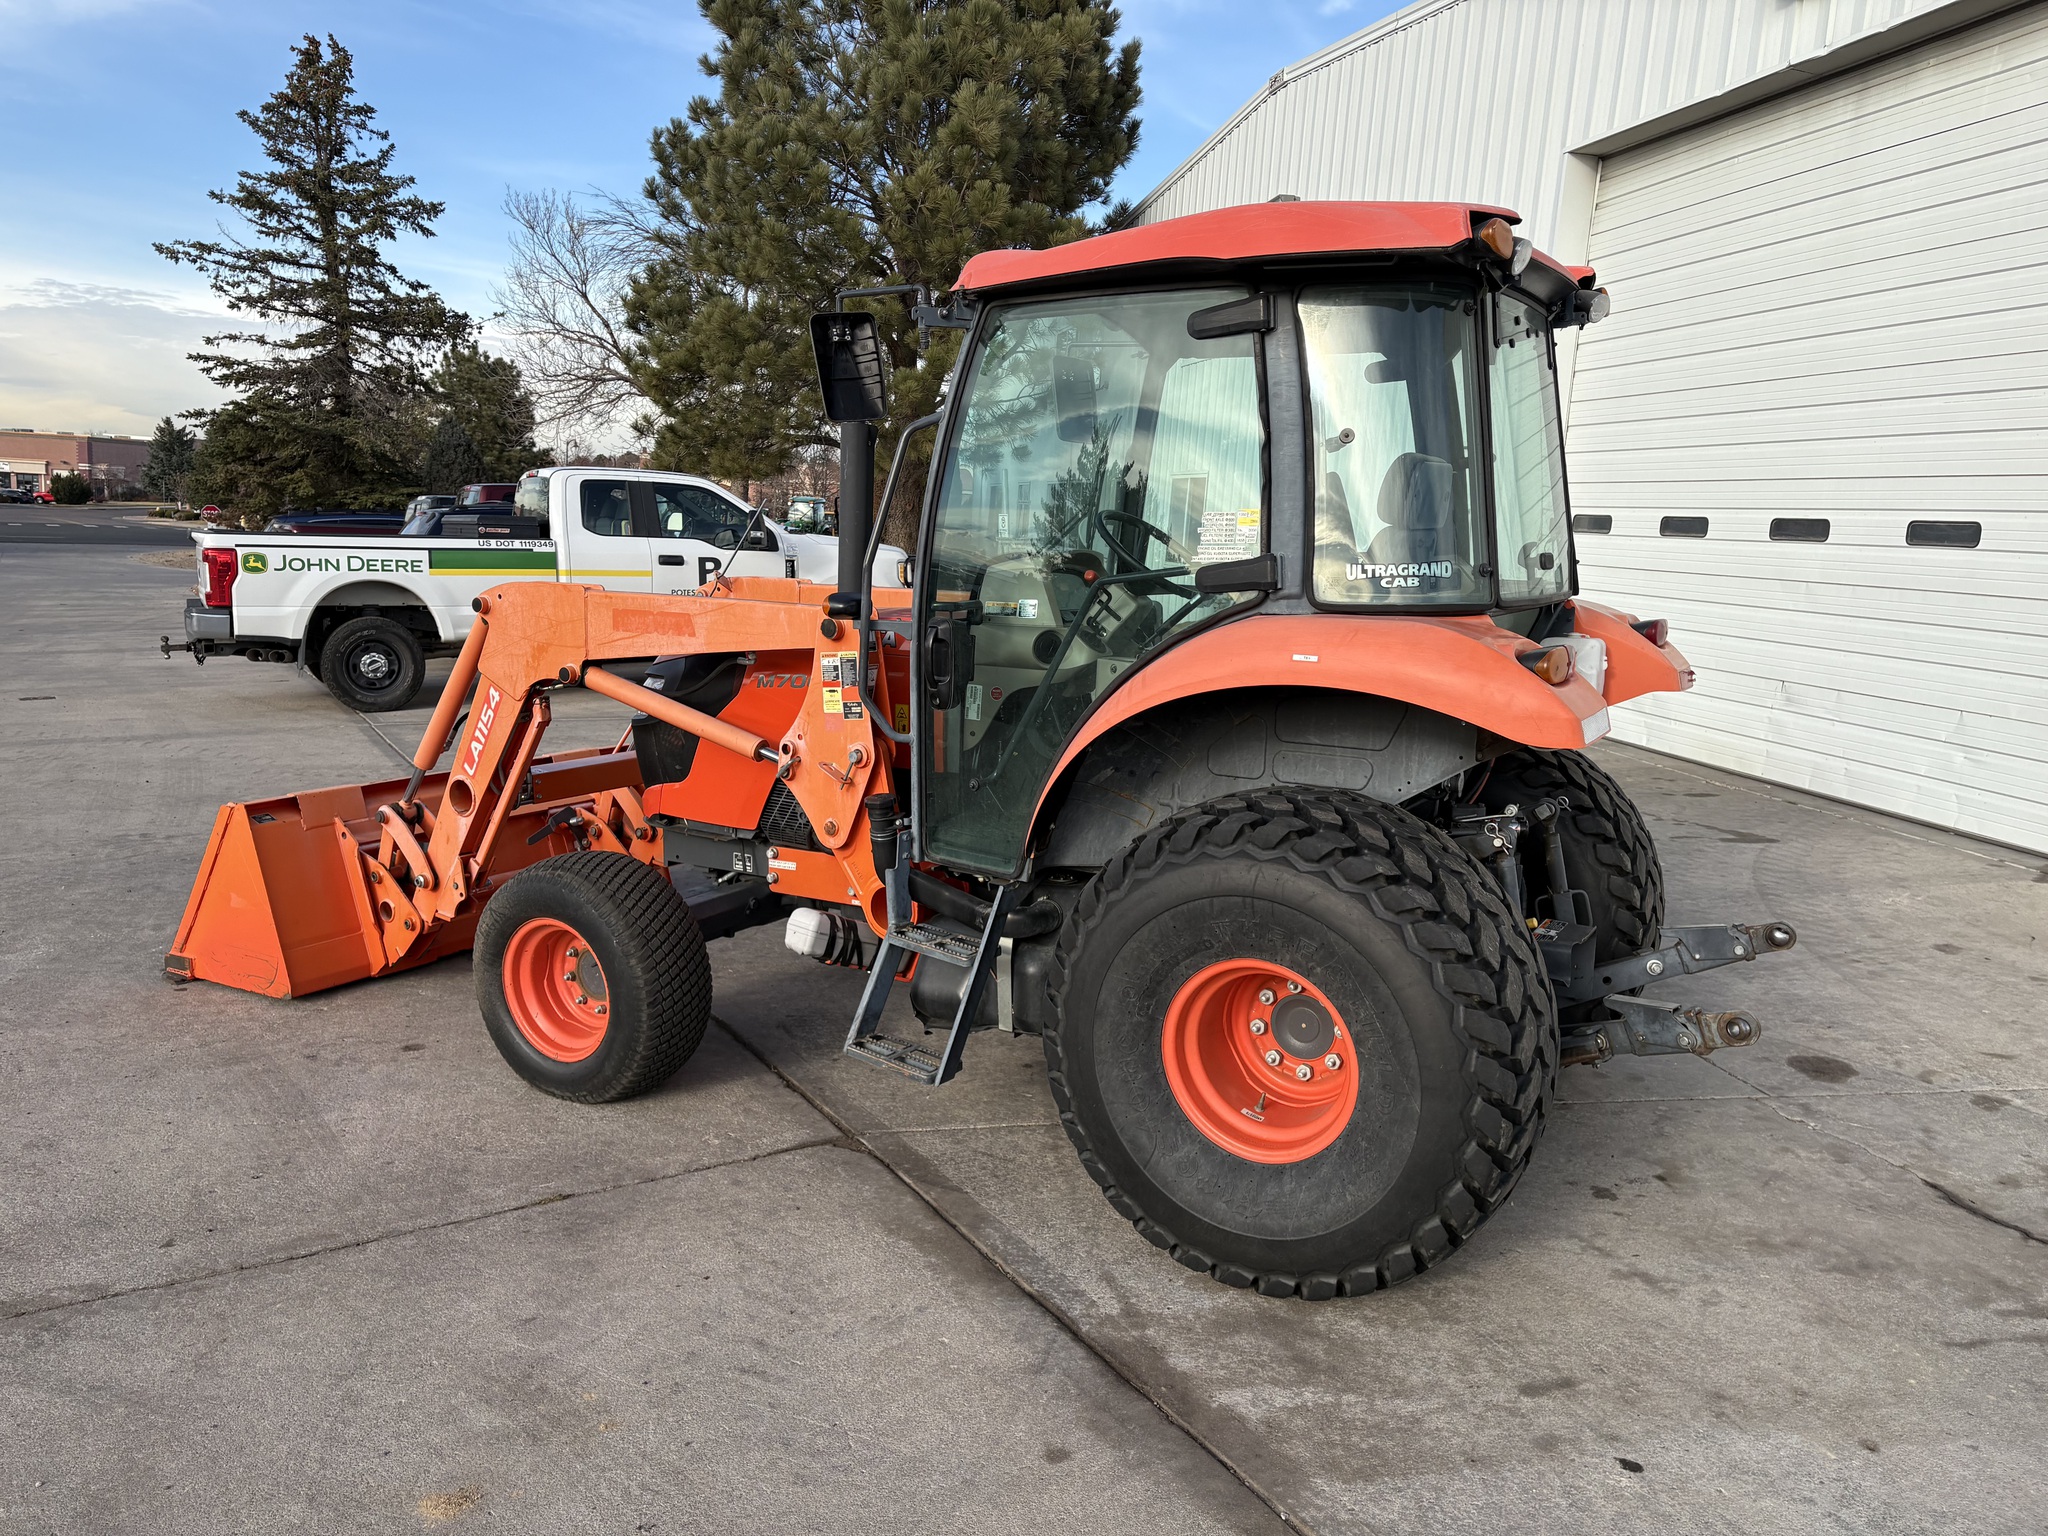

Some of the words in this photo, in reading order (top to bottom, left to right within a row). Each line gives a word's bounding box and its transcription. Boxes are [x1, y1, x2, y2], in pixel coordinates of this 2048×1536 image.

[274, 554, 341, 572] JOHN
[347, 555, 424, 573] DEERE
[1345, 560, 1453, 581] ULTRAGRAND
[1380, 577, 1421, 588] CAB
[463, 685, 501, 776] LA1154
